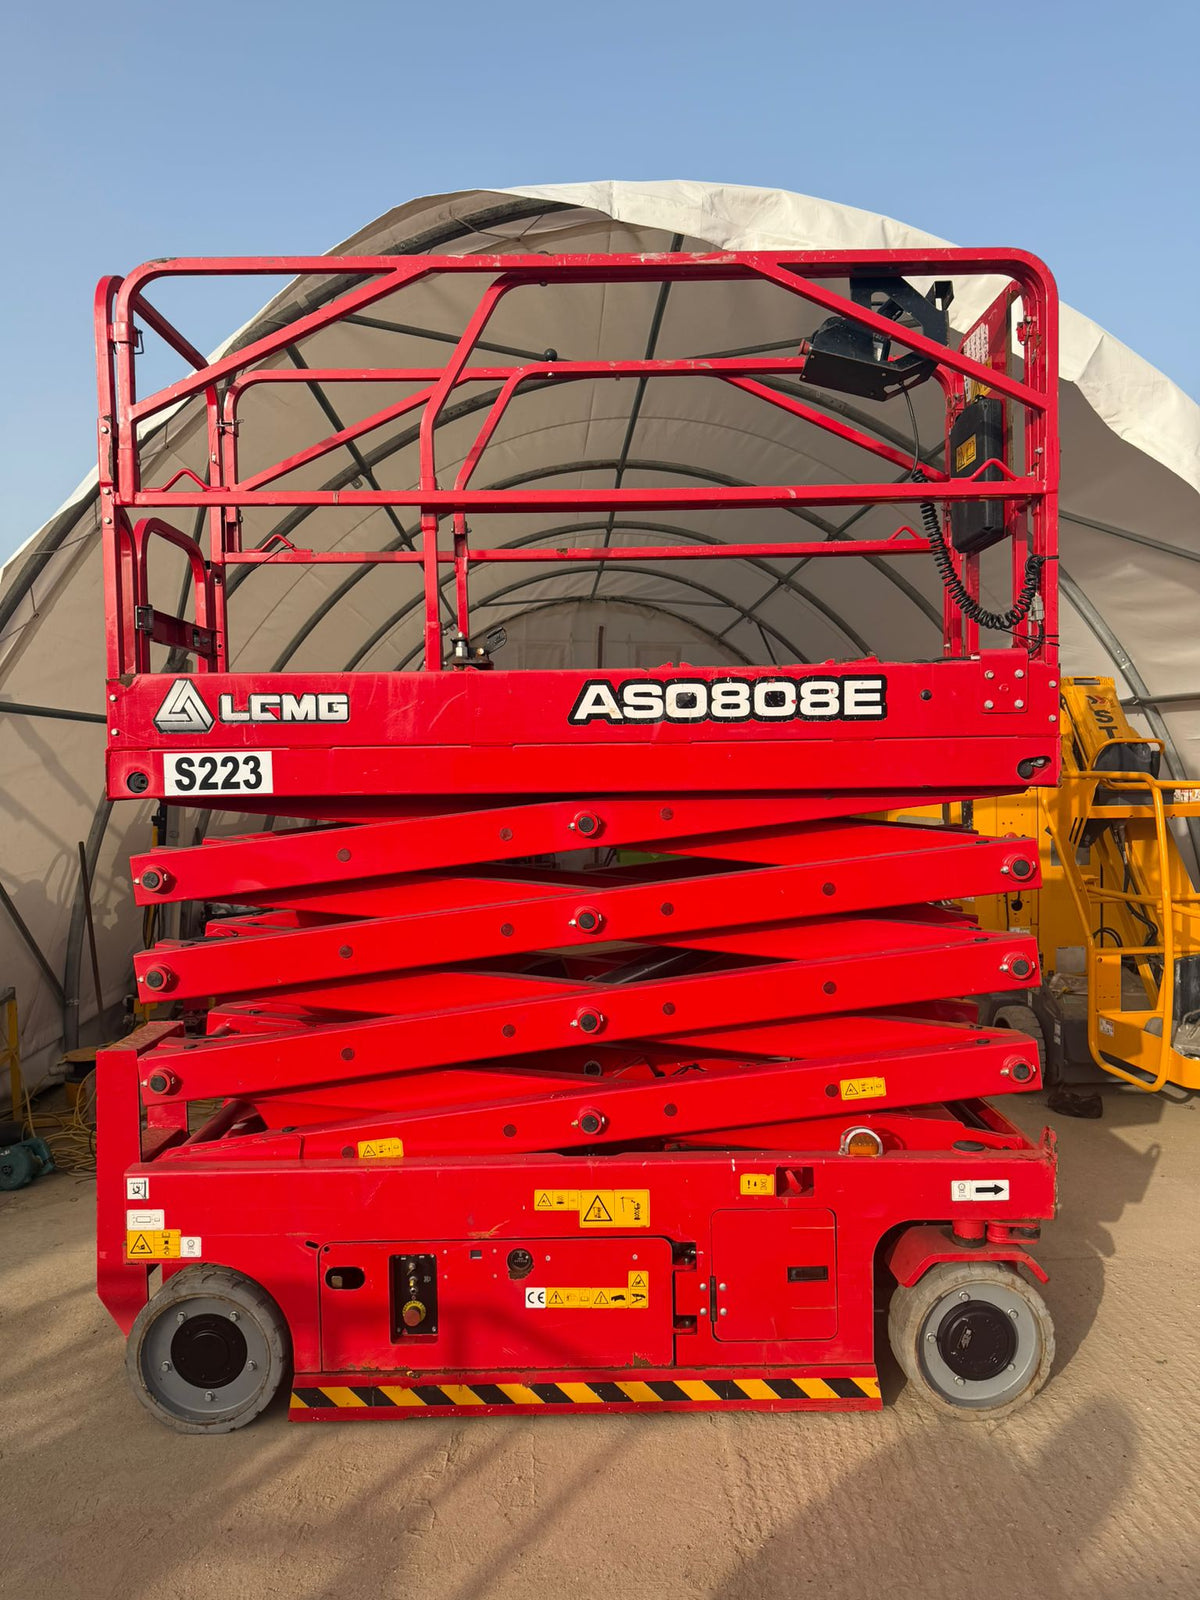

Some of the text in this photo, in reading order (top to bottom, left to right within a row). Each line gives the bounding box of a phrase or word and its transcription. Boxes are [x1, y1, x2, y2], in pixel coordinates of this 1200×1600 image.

[571, 677, 885, 722] AS0808E
[174, 755, 263, 791] S223
[527, 1291, 545, 1304] CE
